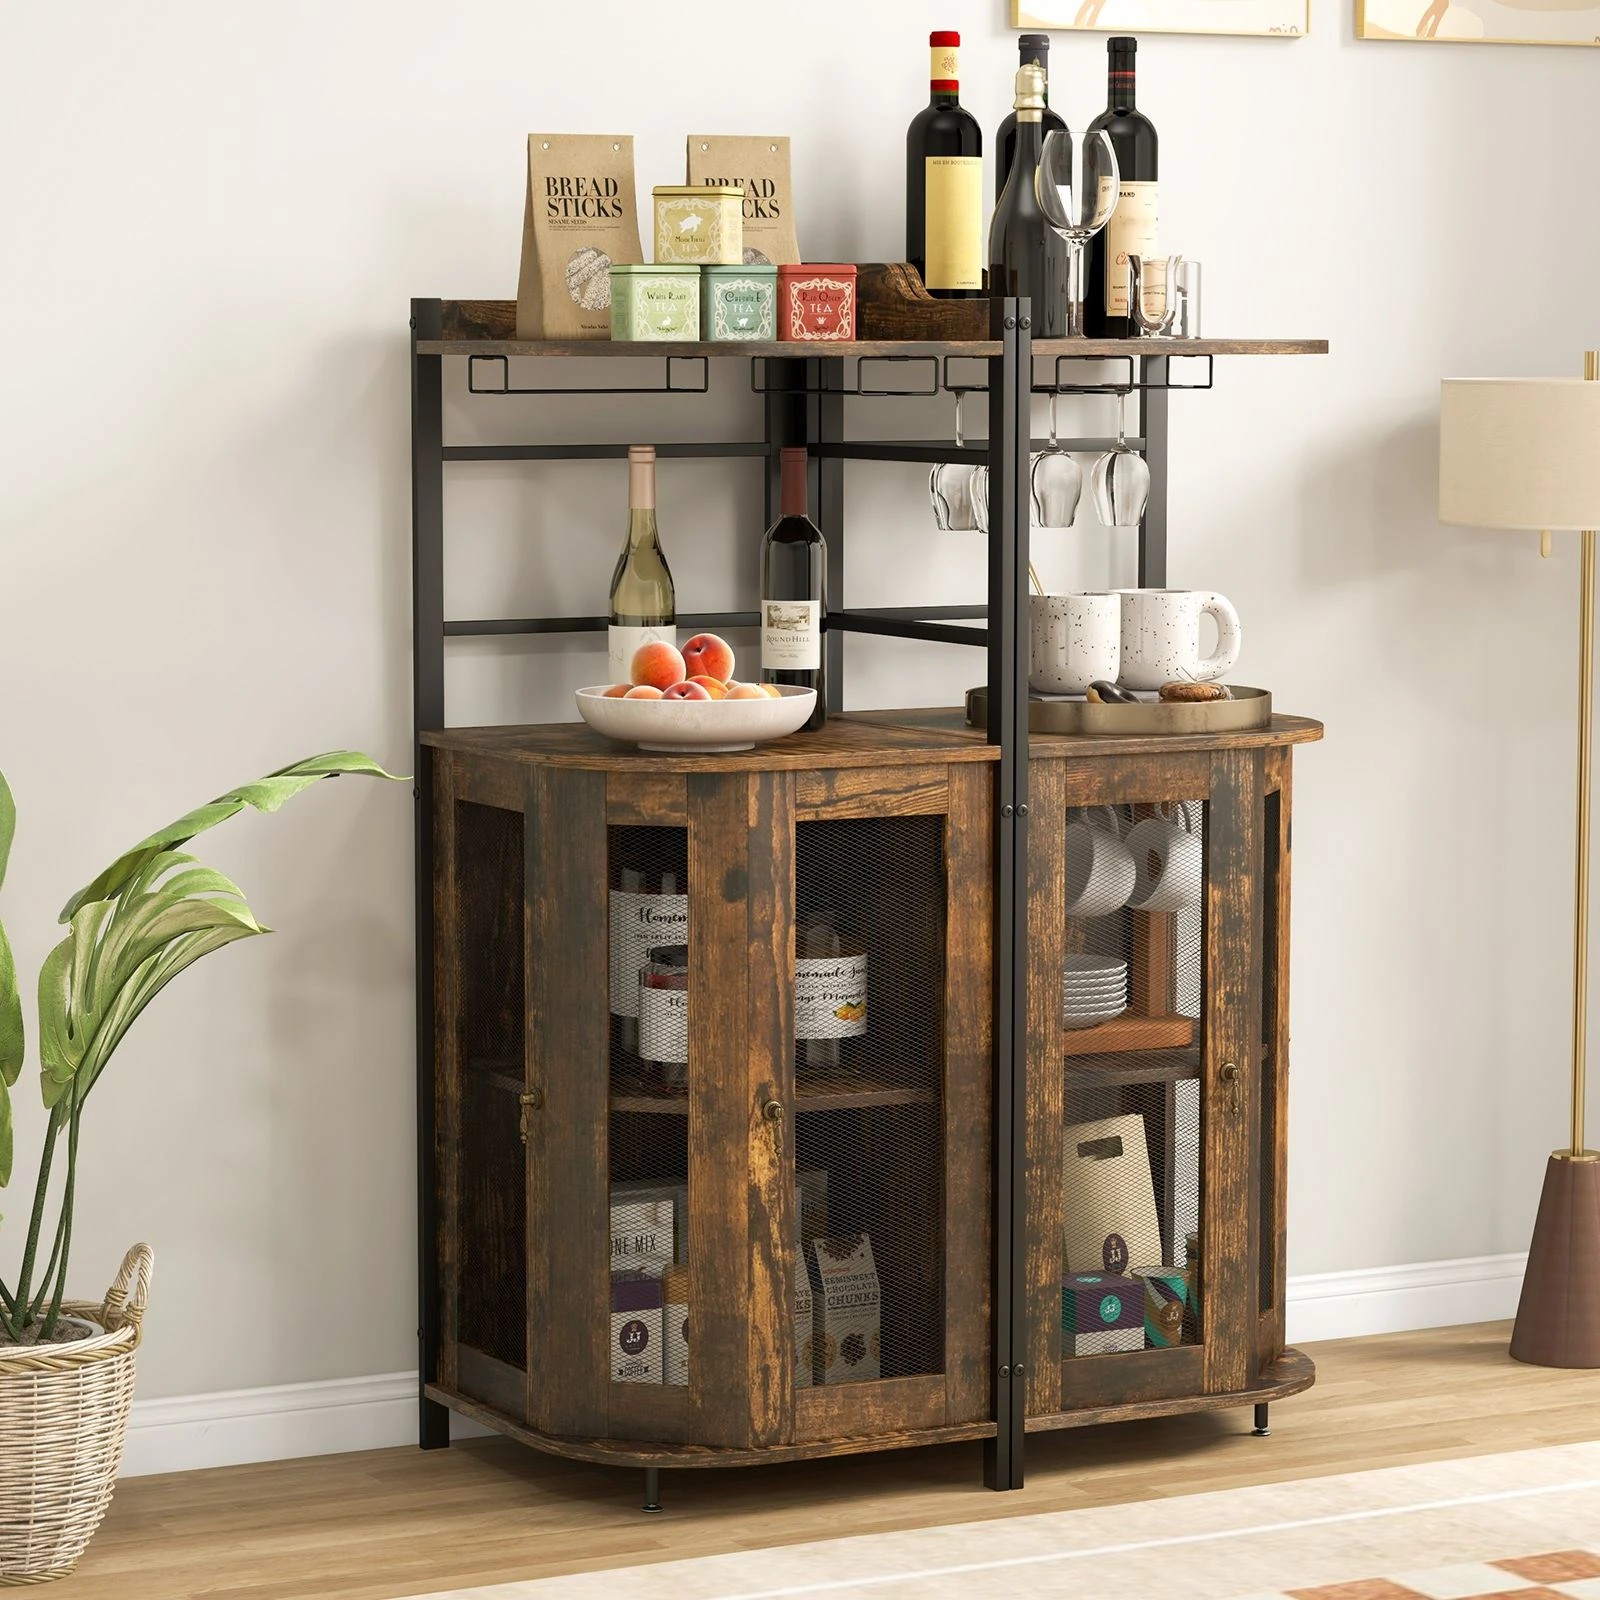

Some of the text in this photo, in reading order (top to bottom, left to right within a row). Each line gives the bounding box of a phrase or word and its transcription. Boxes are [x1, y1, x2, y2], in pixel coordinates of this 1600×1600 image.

[544, 176, 618, 197] BREAD
[547, 198, 623, 218] STICKS
[742, 198, 780, 218] CKS
[682, 243, 699, 252] TEA
[655, 302, 678, 312] TEA
[733, 304, 754, 313] TEA
[810, 303, 832, 313] TEA
[635, 1234, 656, 1253] MIX
[826, 1281, 879, 1295] CHOCOLATE
[827, 1291, 879, 1307] CHUNKS
